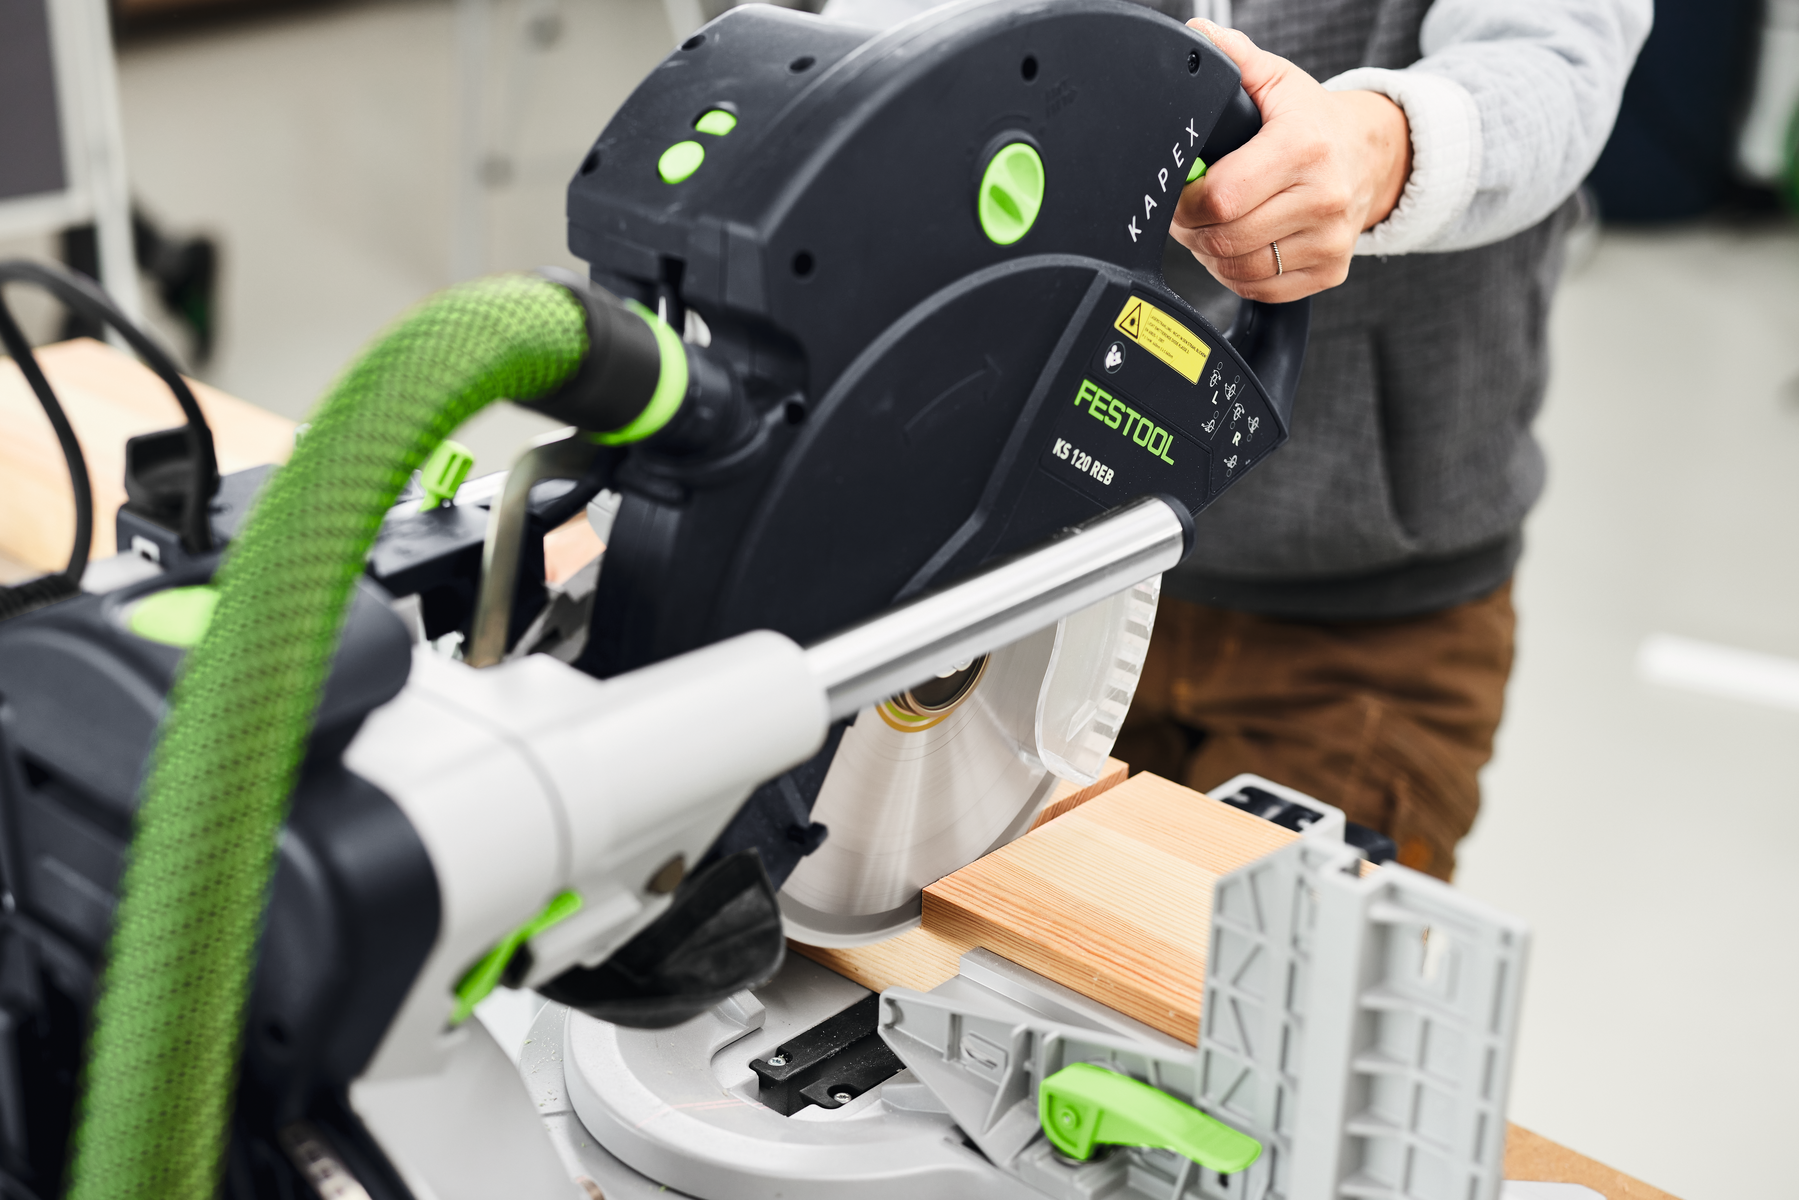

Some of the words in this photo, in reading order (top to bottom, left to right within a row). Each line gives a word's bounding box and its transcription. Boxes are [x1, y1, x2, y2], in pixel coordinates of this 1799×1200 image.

[1127, 117, 1199, 243] KAPEX
[1073, 378, 1175, 466] FESTOOL
[1211, 390, 1219, 405] L
[1052, 437, 1072, 460] KS
[1070, 448, 1092, 472] 120
[1089, 460, 1115, 486] REB
[1231, 431, 1242, 447] R
